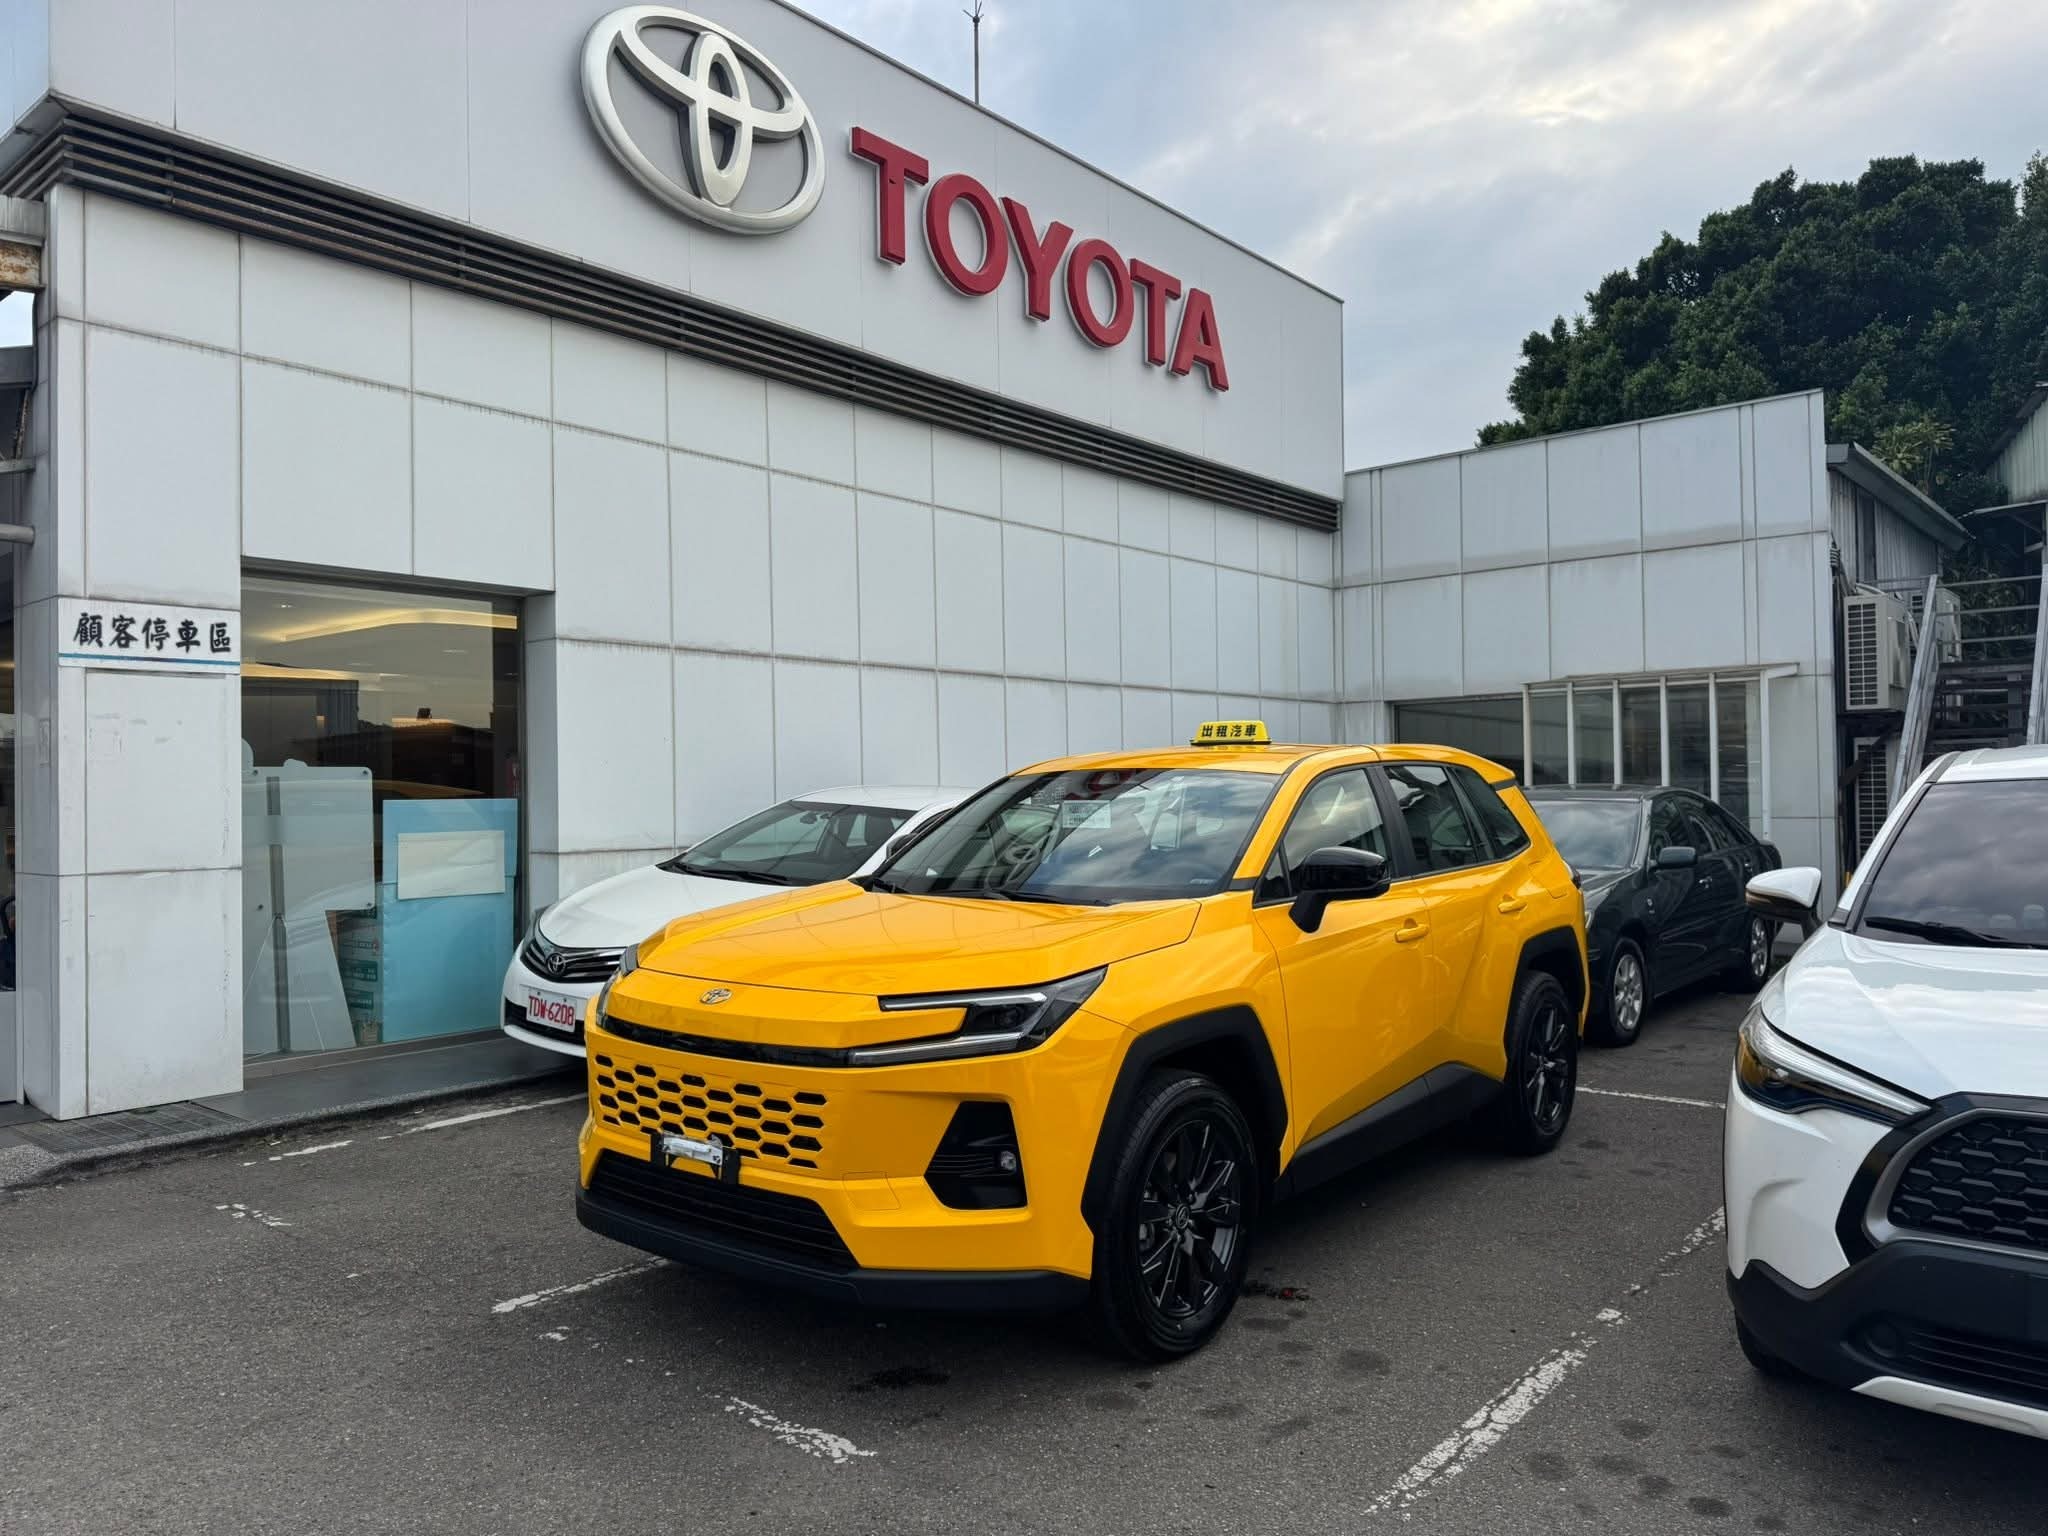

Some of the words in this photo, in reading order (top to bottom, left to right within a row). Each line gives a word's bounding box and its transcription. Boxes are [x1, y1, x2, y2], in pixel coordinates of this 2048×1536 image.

[850, 126, 1229, 392] TOYOTA
[74, 612, 231, 654] 顧客停車區
[1201, 724, 1257, 737] 出租汽車
[528, 995, 575, 1026] TDW-6208
